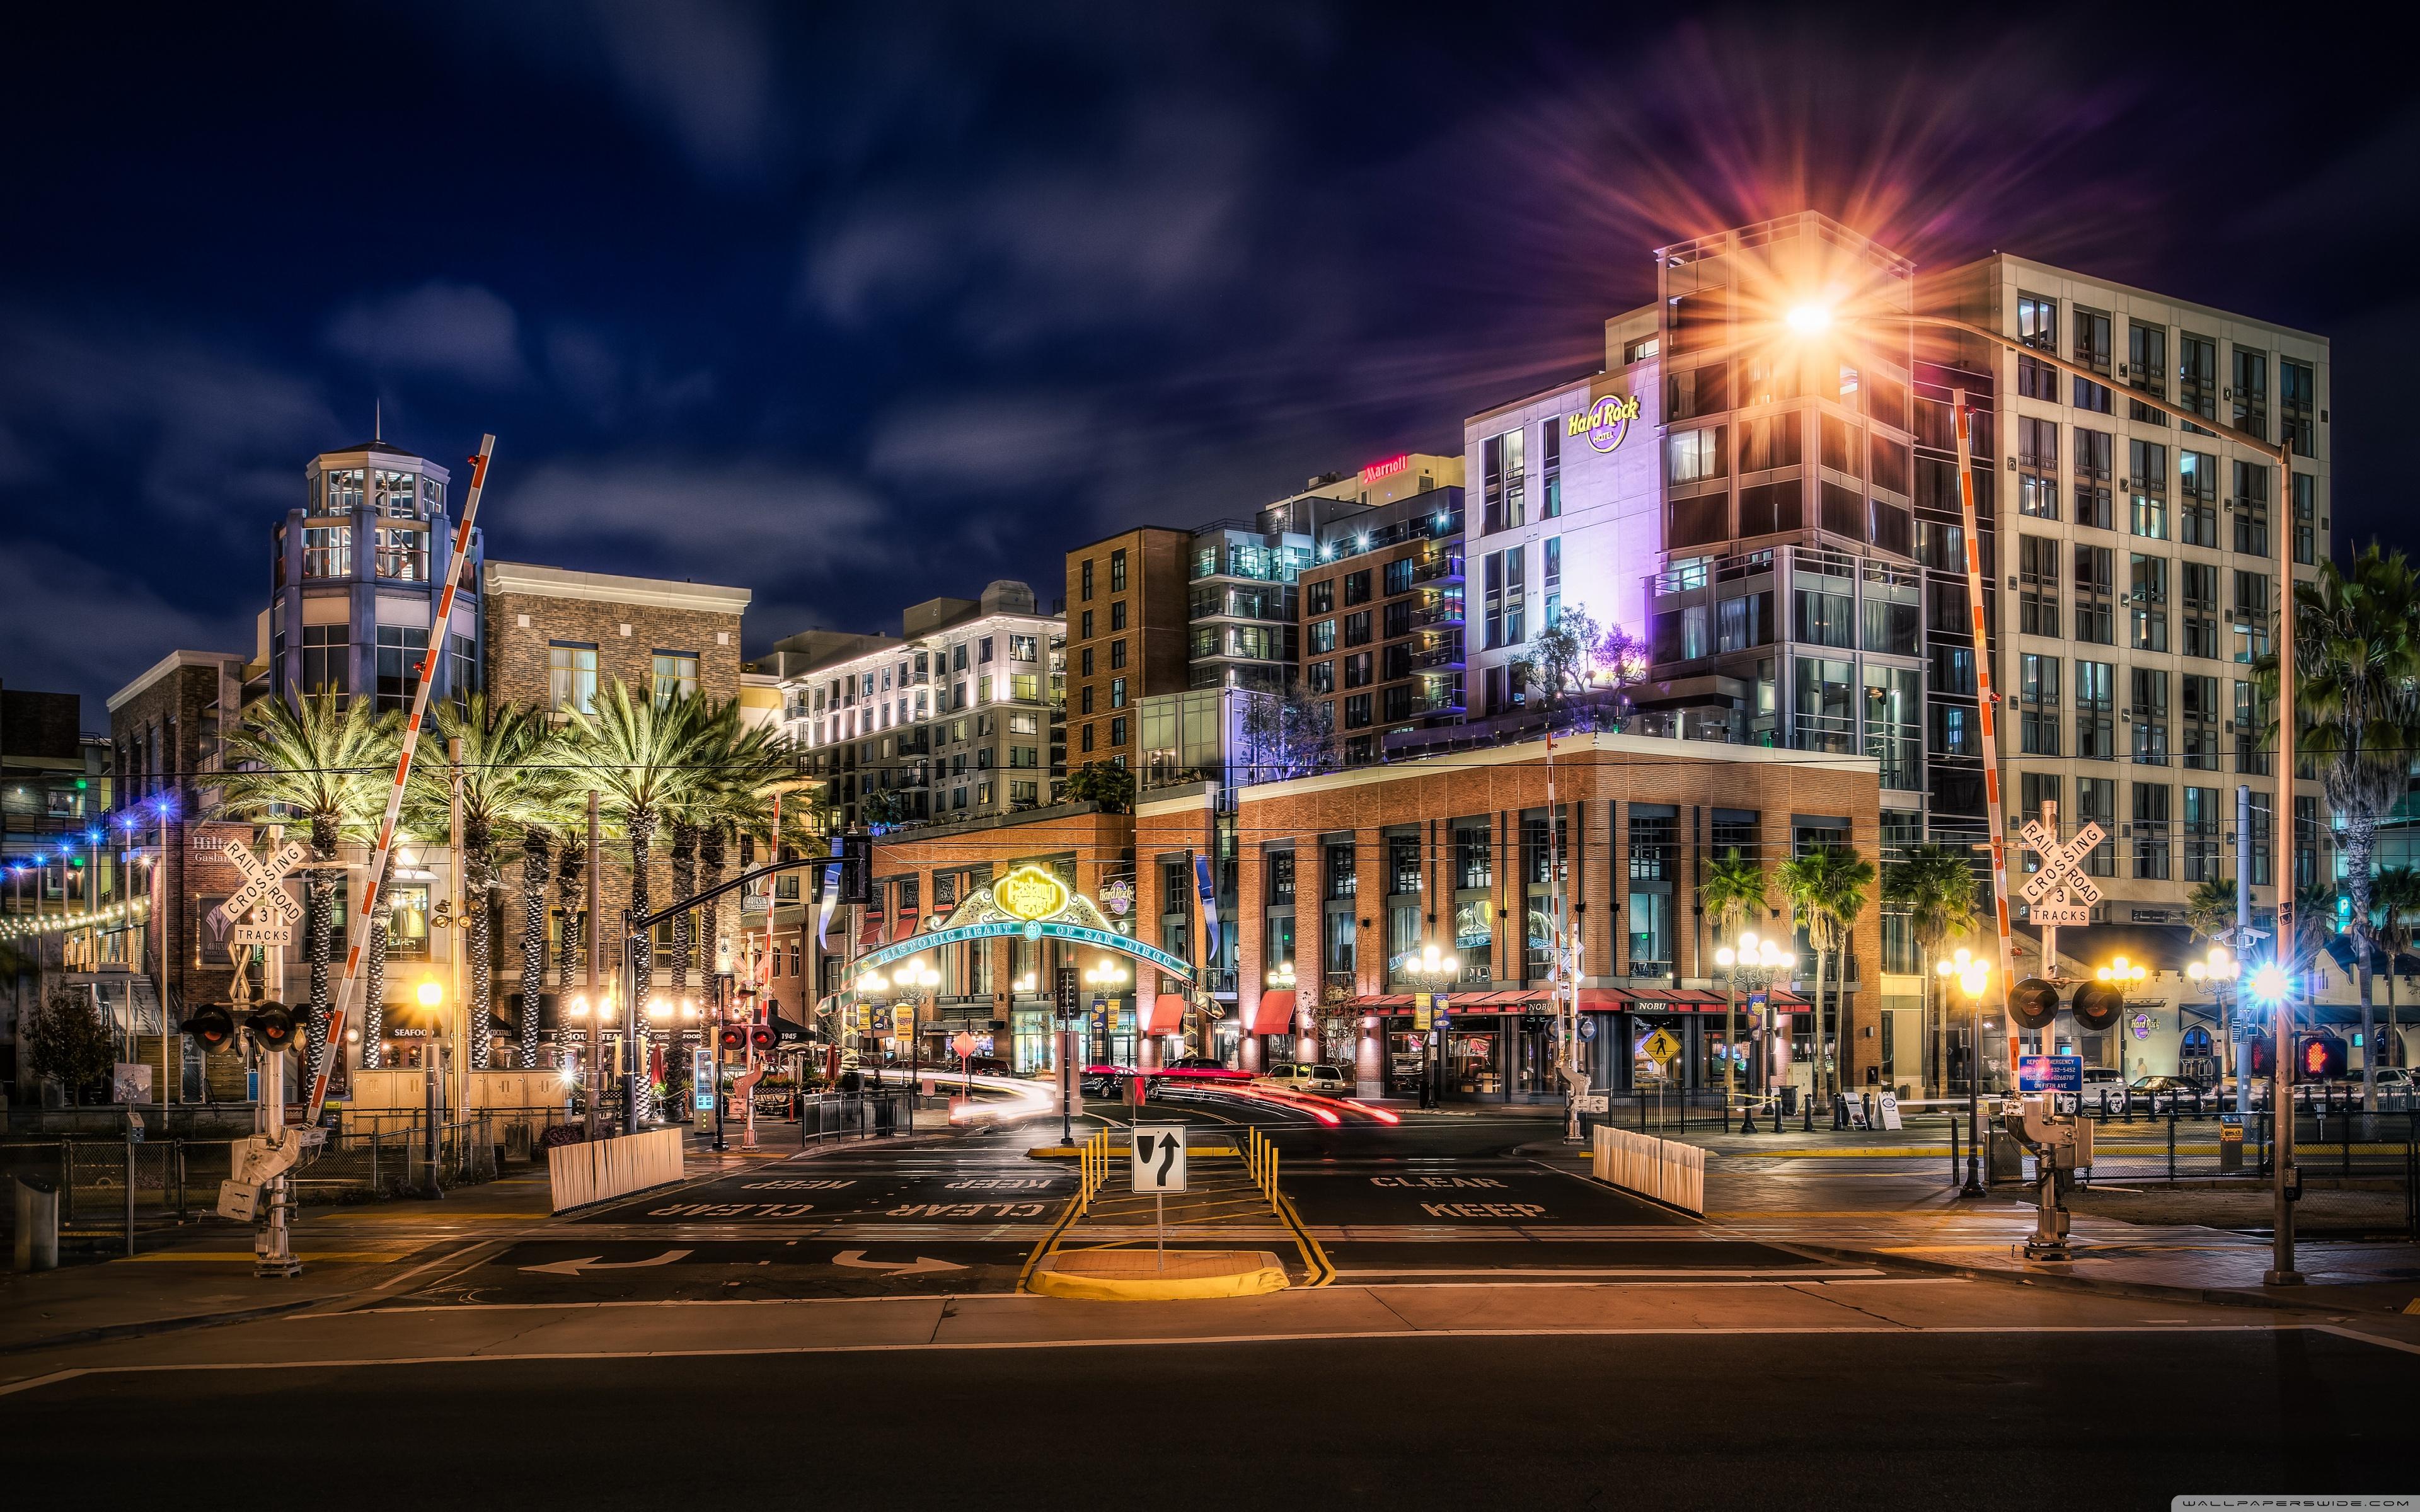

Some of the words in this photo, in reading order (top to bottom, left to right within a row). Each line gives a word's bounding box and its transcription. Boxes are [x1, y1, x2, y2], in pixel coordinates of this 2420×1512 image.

[1568, 406, 1604, 437] Hard
[1604, 396, 1640, 427] Rock
[1593, 431, 1614, 443] HOTEL
[1364, 455, 1406, 484] Marriott
[193, 836, 231, 849] Hilto
[2025, 824, 2053, 857] RAIL
[2065, 868, 2098, 902] ROAD
[2027, 830, 2098, 896] CROSSING
[227, 843, 255, 876] RAIL
[267, 886, 299, 919] ROAD
[228, 848, 299, 914] CROSSING
[2056, 890, 2064, 902] 3
[260, 910, 268, 922] 3
[2034, 910, 2085, 920] TRACKS
[238, 930, 288, 940] TRACKS
[878, 931, 955, 963] HISTORIC
[961, 923, 1012, 939] HEART
[1056, 925, 1075, 936] OF
[1084, 929, 1114, 944] SAN
[1124, 939, 1173, 966] DIEGO
[2131, 1019, 2146, 1028] Hard
[740, 1180, 858, 1189] KEEP
[945, 1179, 1054, 1189] KEEP
[1369, 1177, 1509, 1188] CLEAR
[647, 1204, 815, 1217] CLEAR
[885, 1204, 1046, 1217] CLEAR
[1420, 1204, 1546, 1217] KEEP
